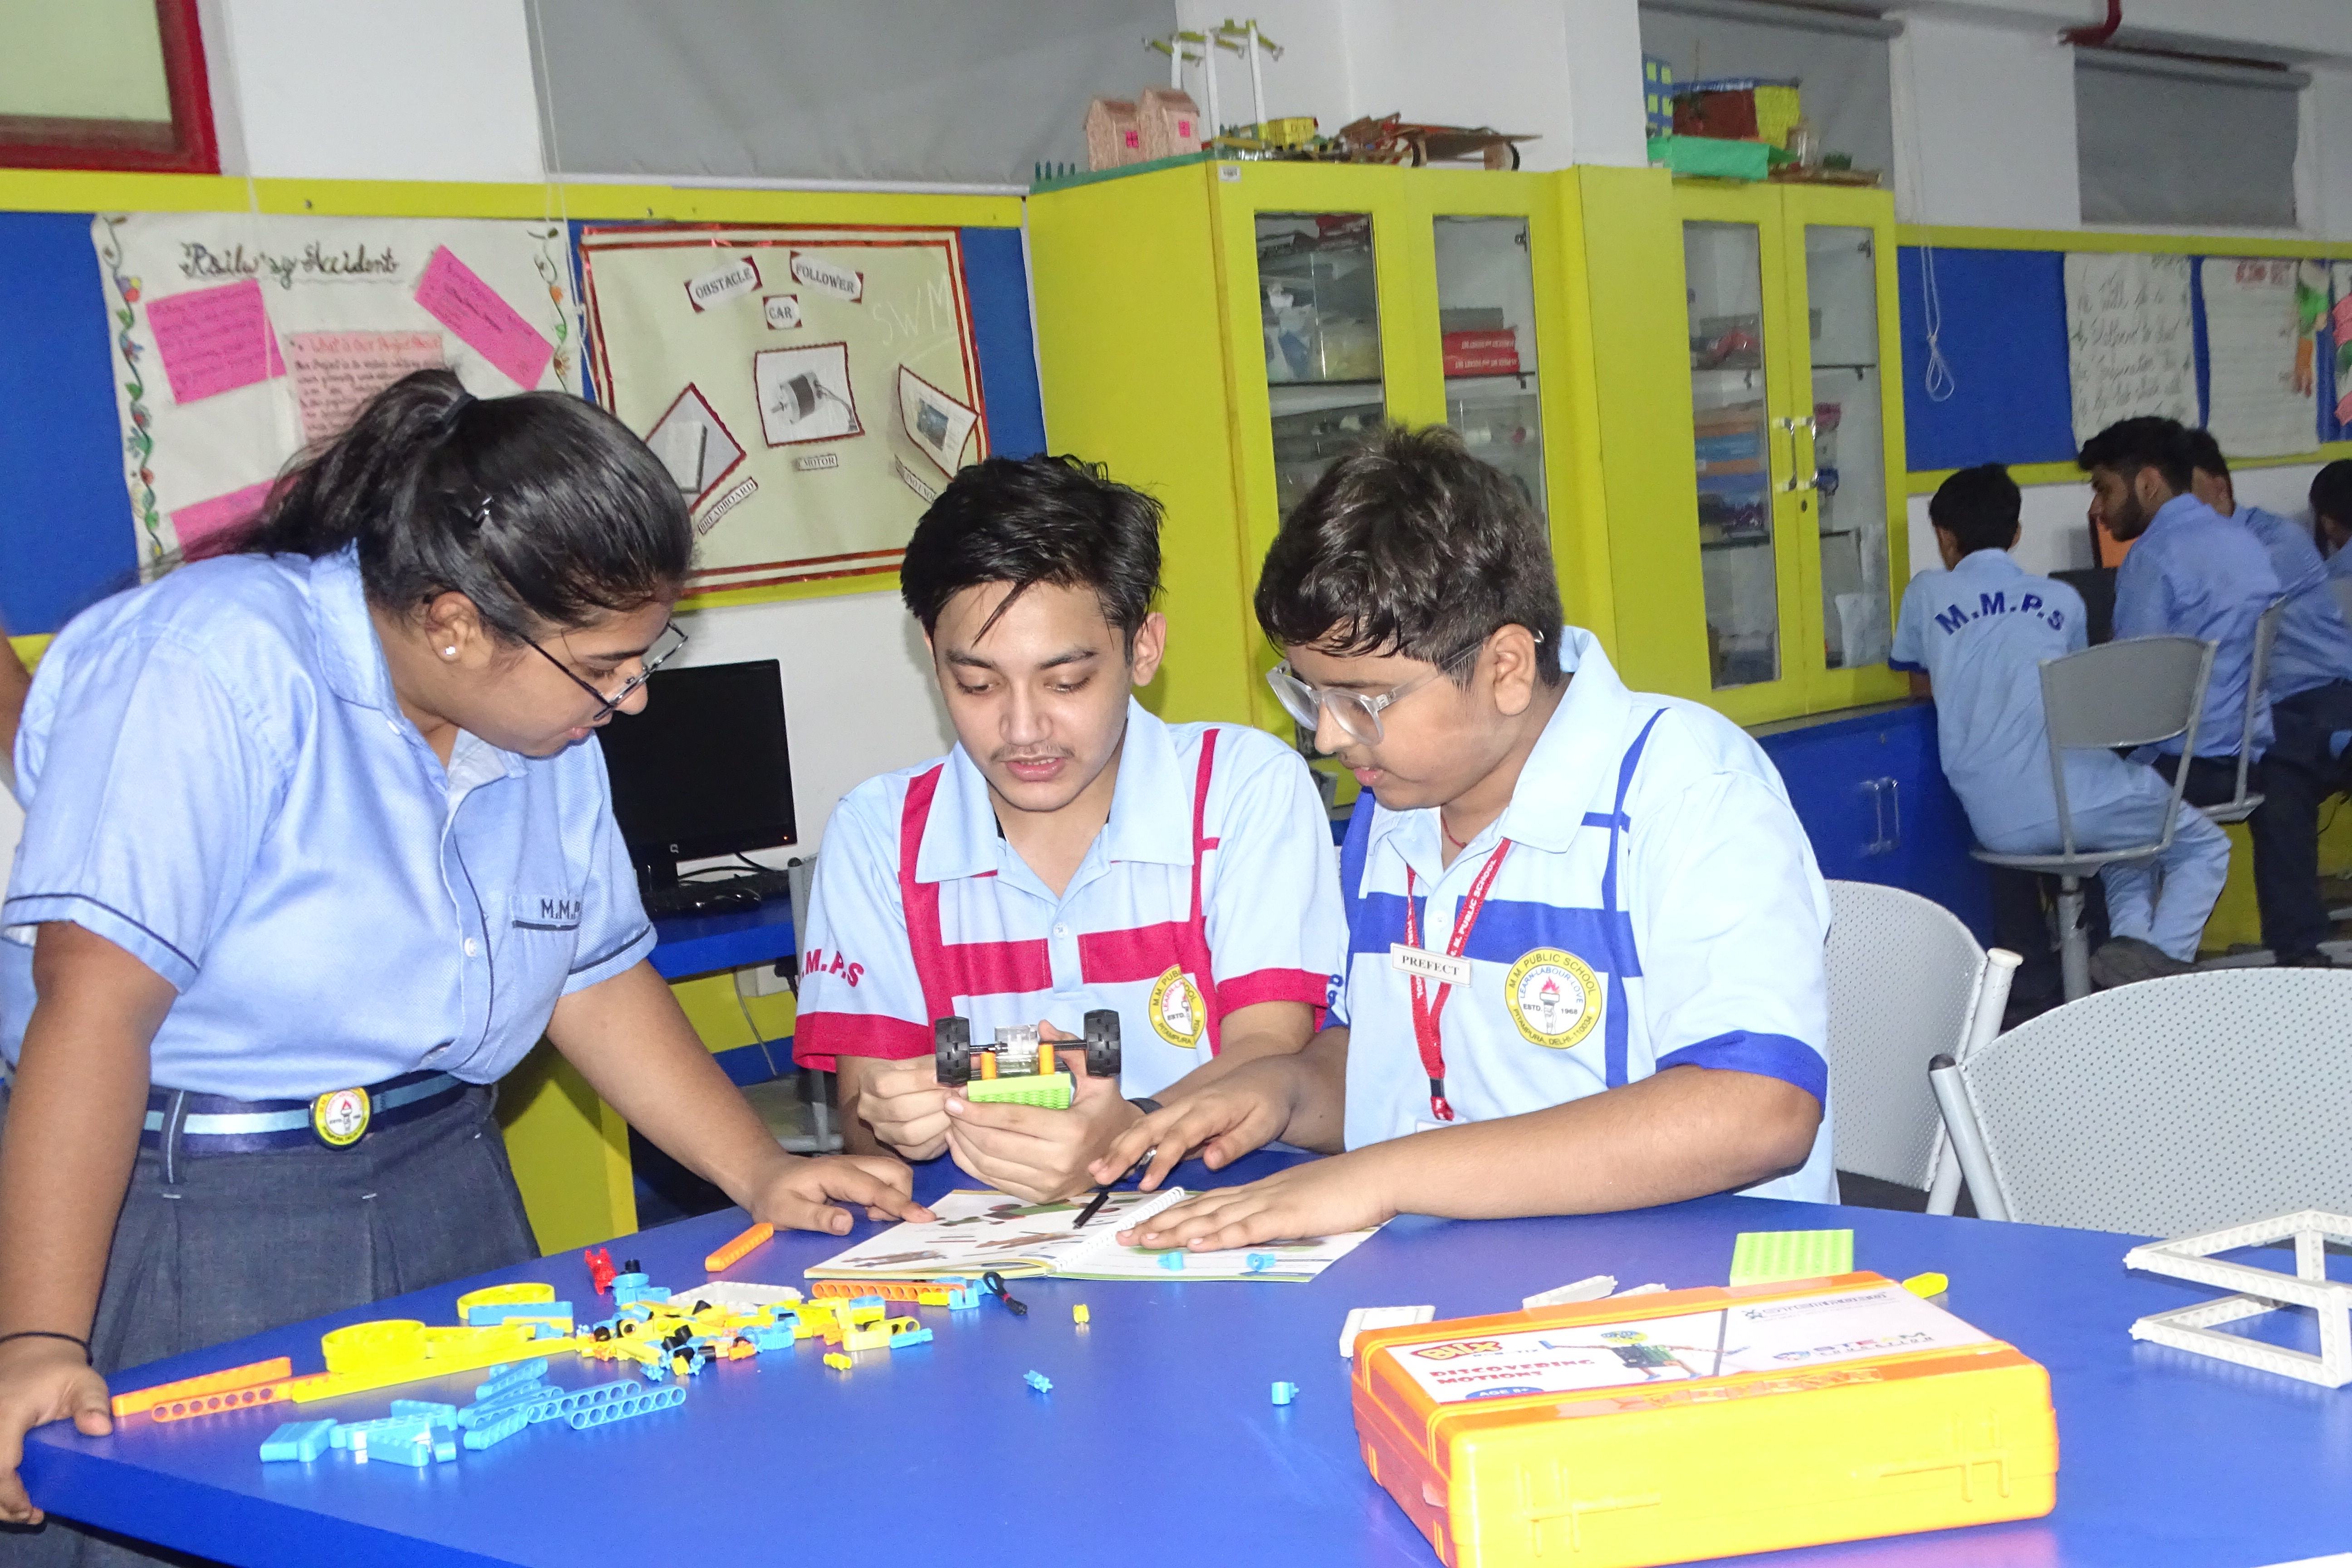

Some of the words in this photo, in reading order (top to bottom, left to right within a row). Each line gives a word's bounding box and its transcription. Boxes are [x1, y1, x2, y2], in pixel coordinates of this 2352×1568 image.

[301, 241, 399, 273] Accident
[695, 267, 753, 299] OBSTACLE
[796, 264, 855, 294] FOLLOWER
[769, 306, 793, 318] CAR
[873, 274, 952, 346] SWM
[803, 457, 835, 467] MOTOR
[1935, 592, 2064, 635] M.M.P.S
[1459, 898, 1477, 934] PUBLIC
[1474, 859, 1497, 897] SCHOOL
[1402, 955, 1460, 975] PREFECT
[1524, 953, 1560, 968] PUBLIC
[1563, 957, 1596, 996] SCHOOL
[1436, 1371, 1543, 1384] MOTIONS
